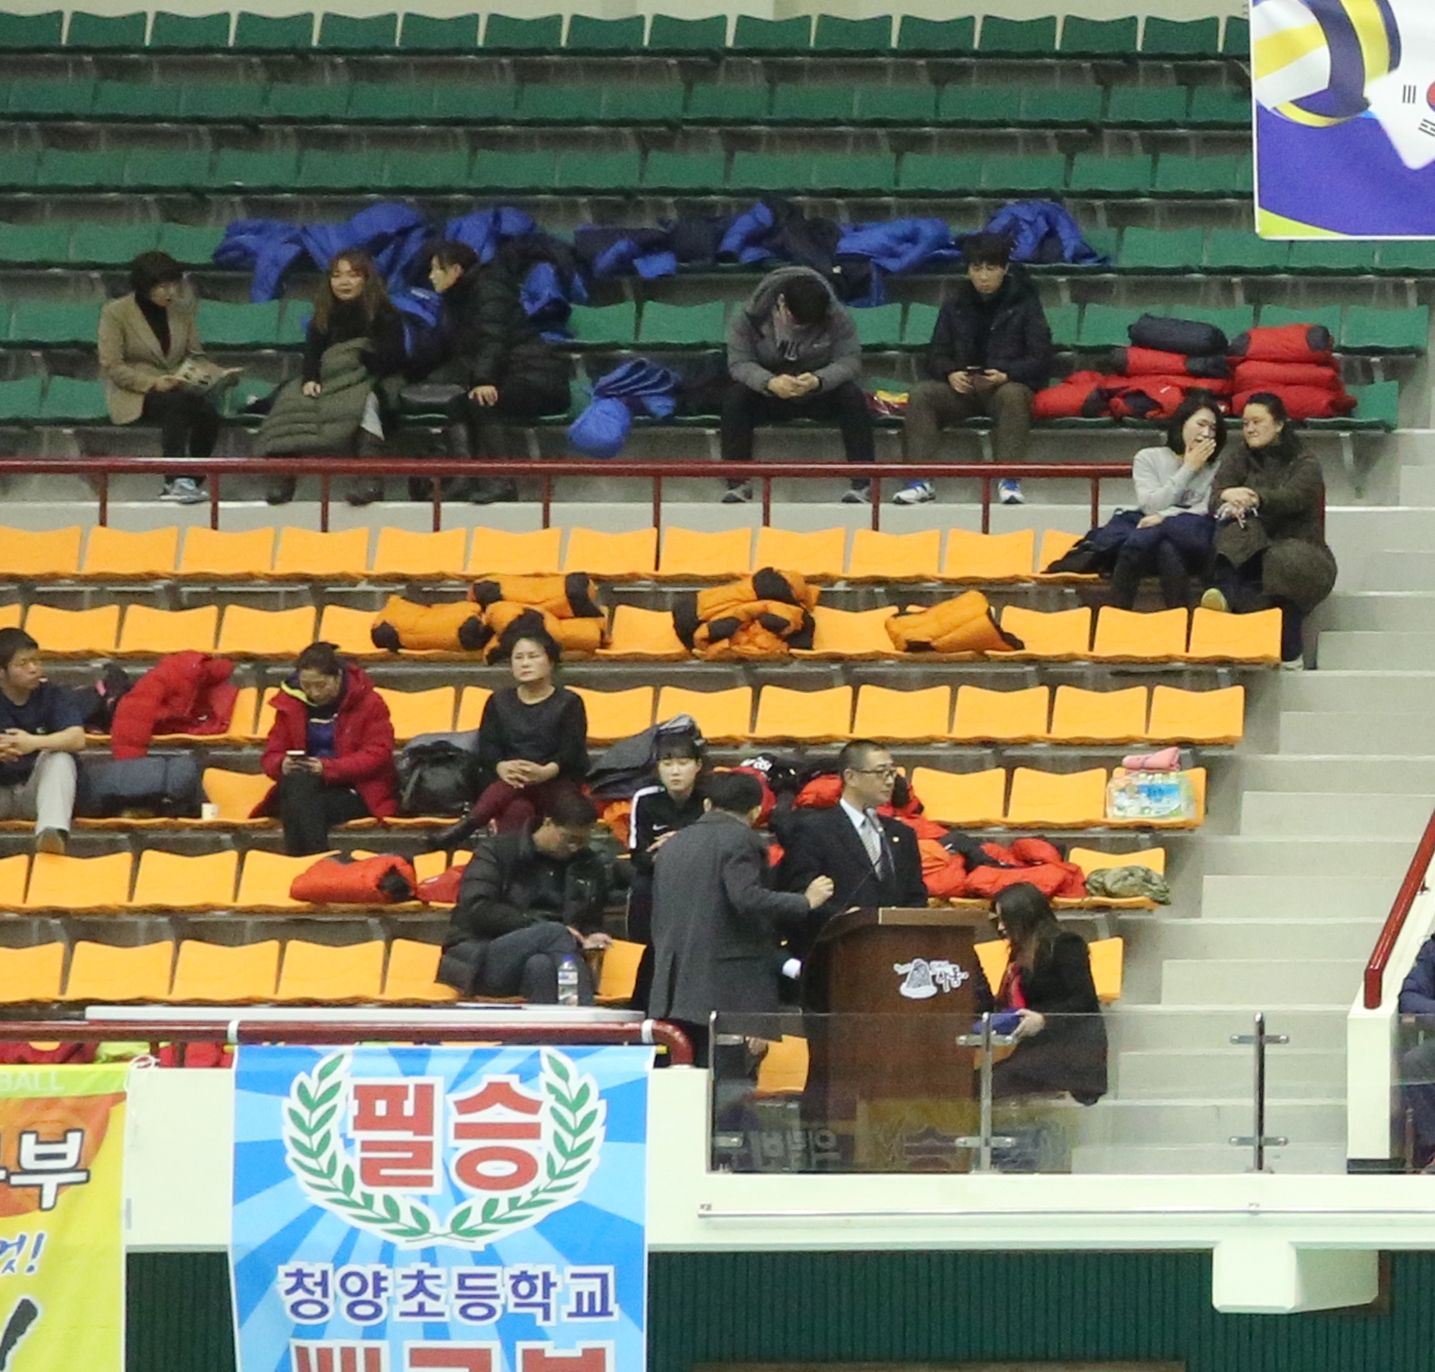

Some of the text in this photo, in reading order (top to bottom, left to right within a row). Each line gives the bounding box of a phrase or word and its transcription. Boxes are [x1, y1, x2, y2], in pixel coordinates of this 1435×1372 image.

[4, 1130, 91, 1212] 부
[350, 1082, 544, 1191] 필승
[282, 1266, 617, 1323] 청양초등학교
